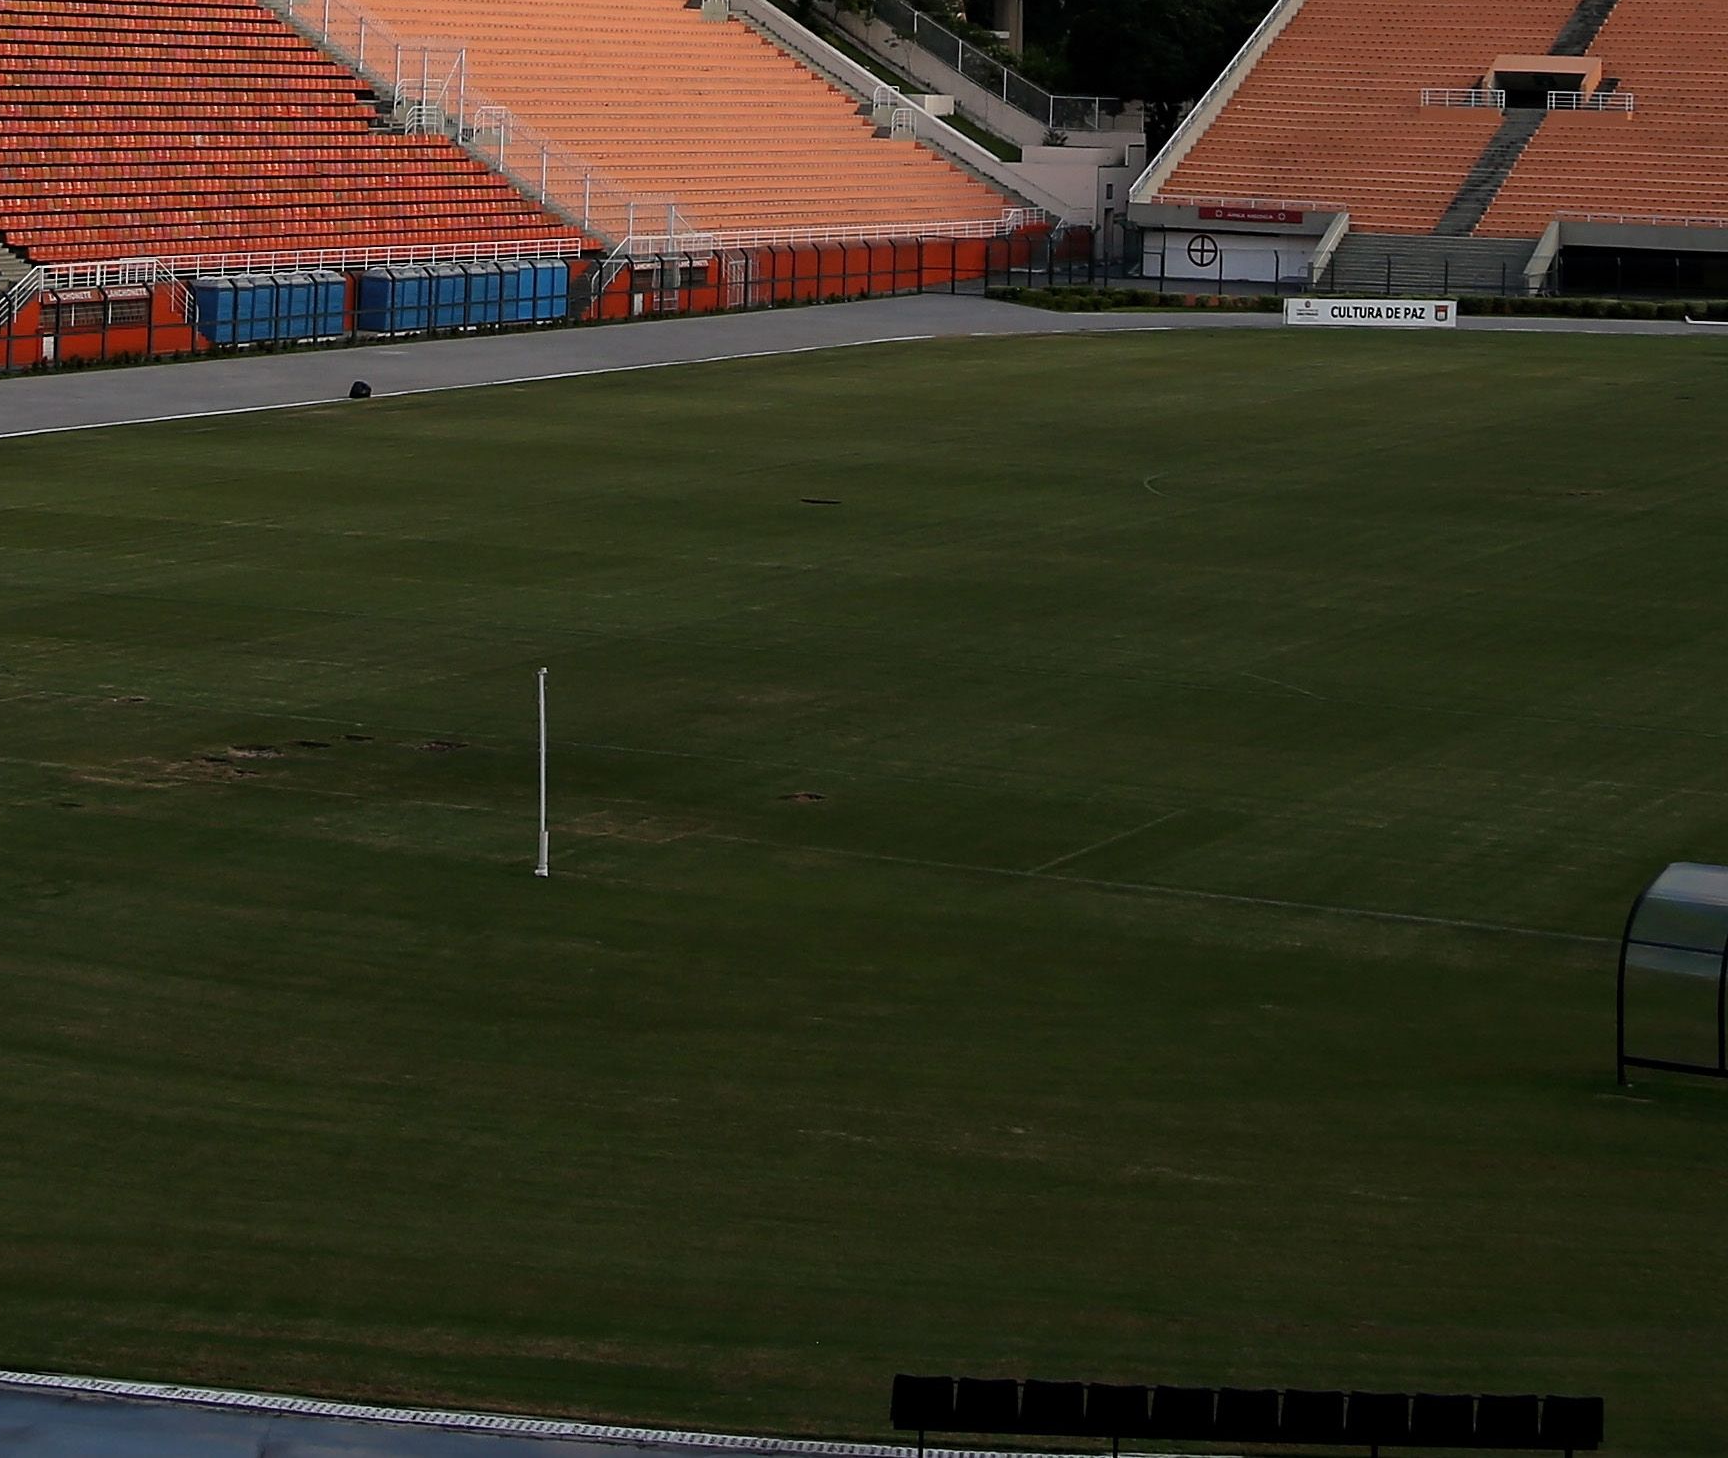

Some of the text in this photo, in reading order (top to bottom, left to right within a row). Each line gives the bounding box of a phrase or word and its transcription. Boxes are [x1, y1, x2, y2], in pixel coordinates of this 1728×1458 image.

[1330, 305, 1383, 319] CULTURA
[1386, 307, 1400, 319] DE
[1404, 307, 1425, 320] PAZ
